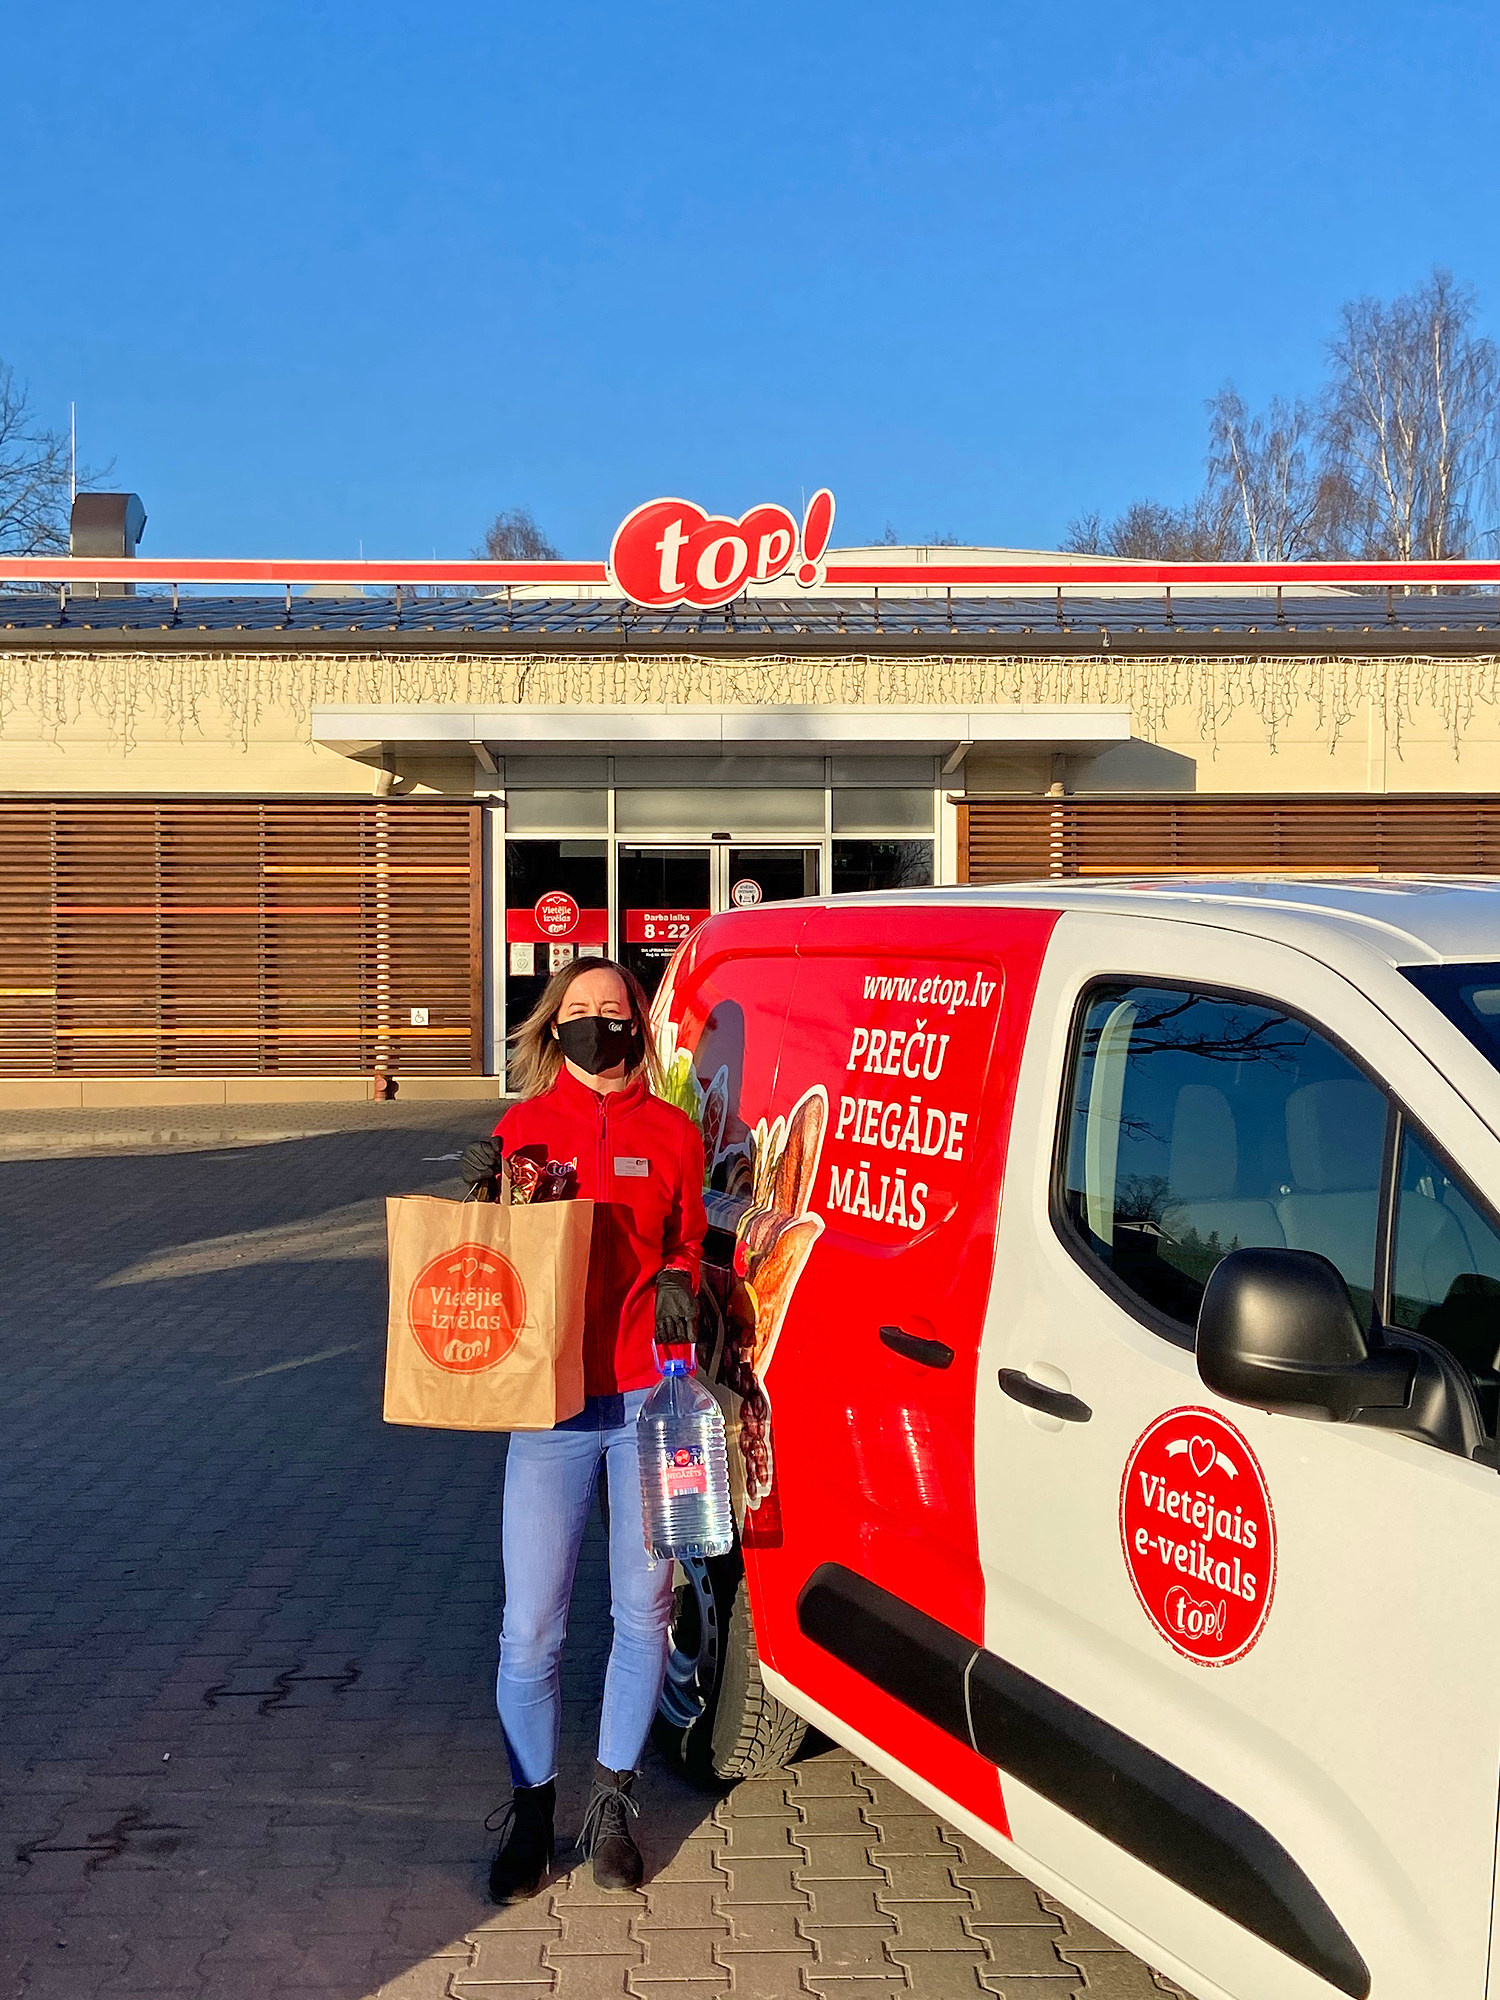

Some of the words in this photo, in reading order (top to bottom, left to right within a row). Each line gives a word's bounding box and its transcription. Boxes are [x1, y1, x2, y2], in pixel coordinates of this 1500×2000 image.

[654, 488, 836, 594] top!
[644, 923, 656, 939] 8
[667, 923, 690, 939] 22
[863, 971, 996, 1015] www.etop.lv
[845, 1018, 950, 1081] PREČU
[834, 1095, 968, 1162] PIEGĀDE
[826, 1160, 929, 1231] MĀJĀS
[430, 1286, 503, 1311] Vietējie
[431, 1309, 501, 1330] izvēlas
[1139, 1470, 1258, 1549] Vietējais
[1135, 1526, 1257, 1602] e-veikals
[1172, 1593, 1227, 1641] top!
